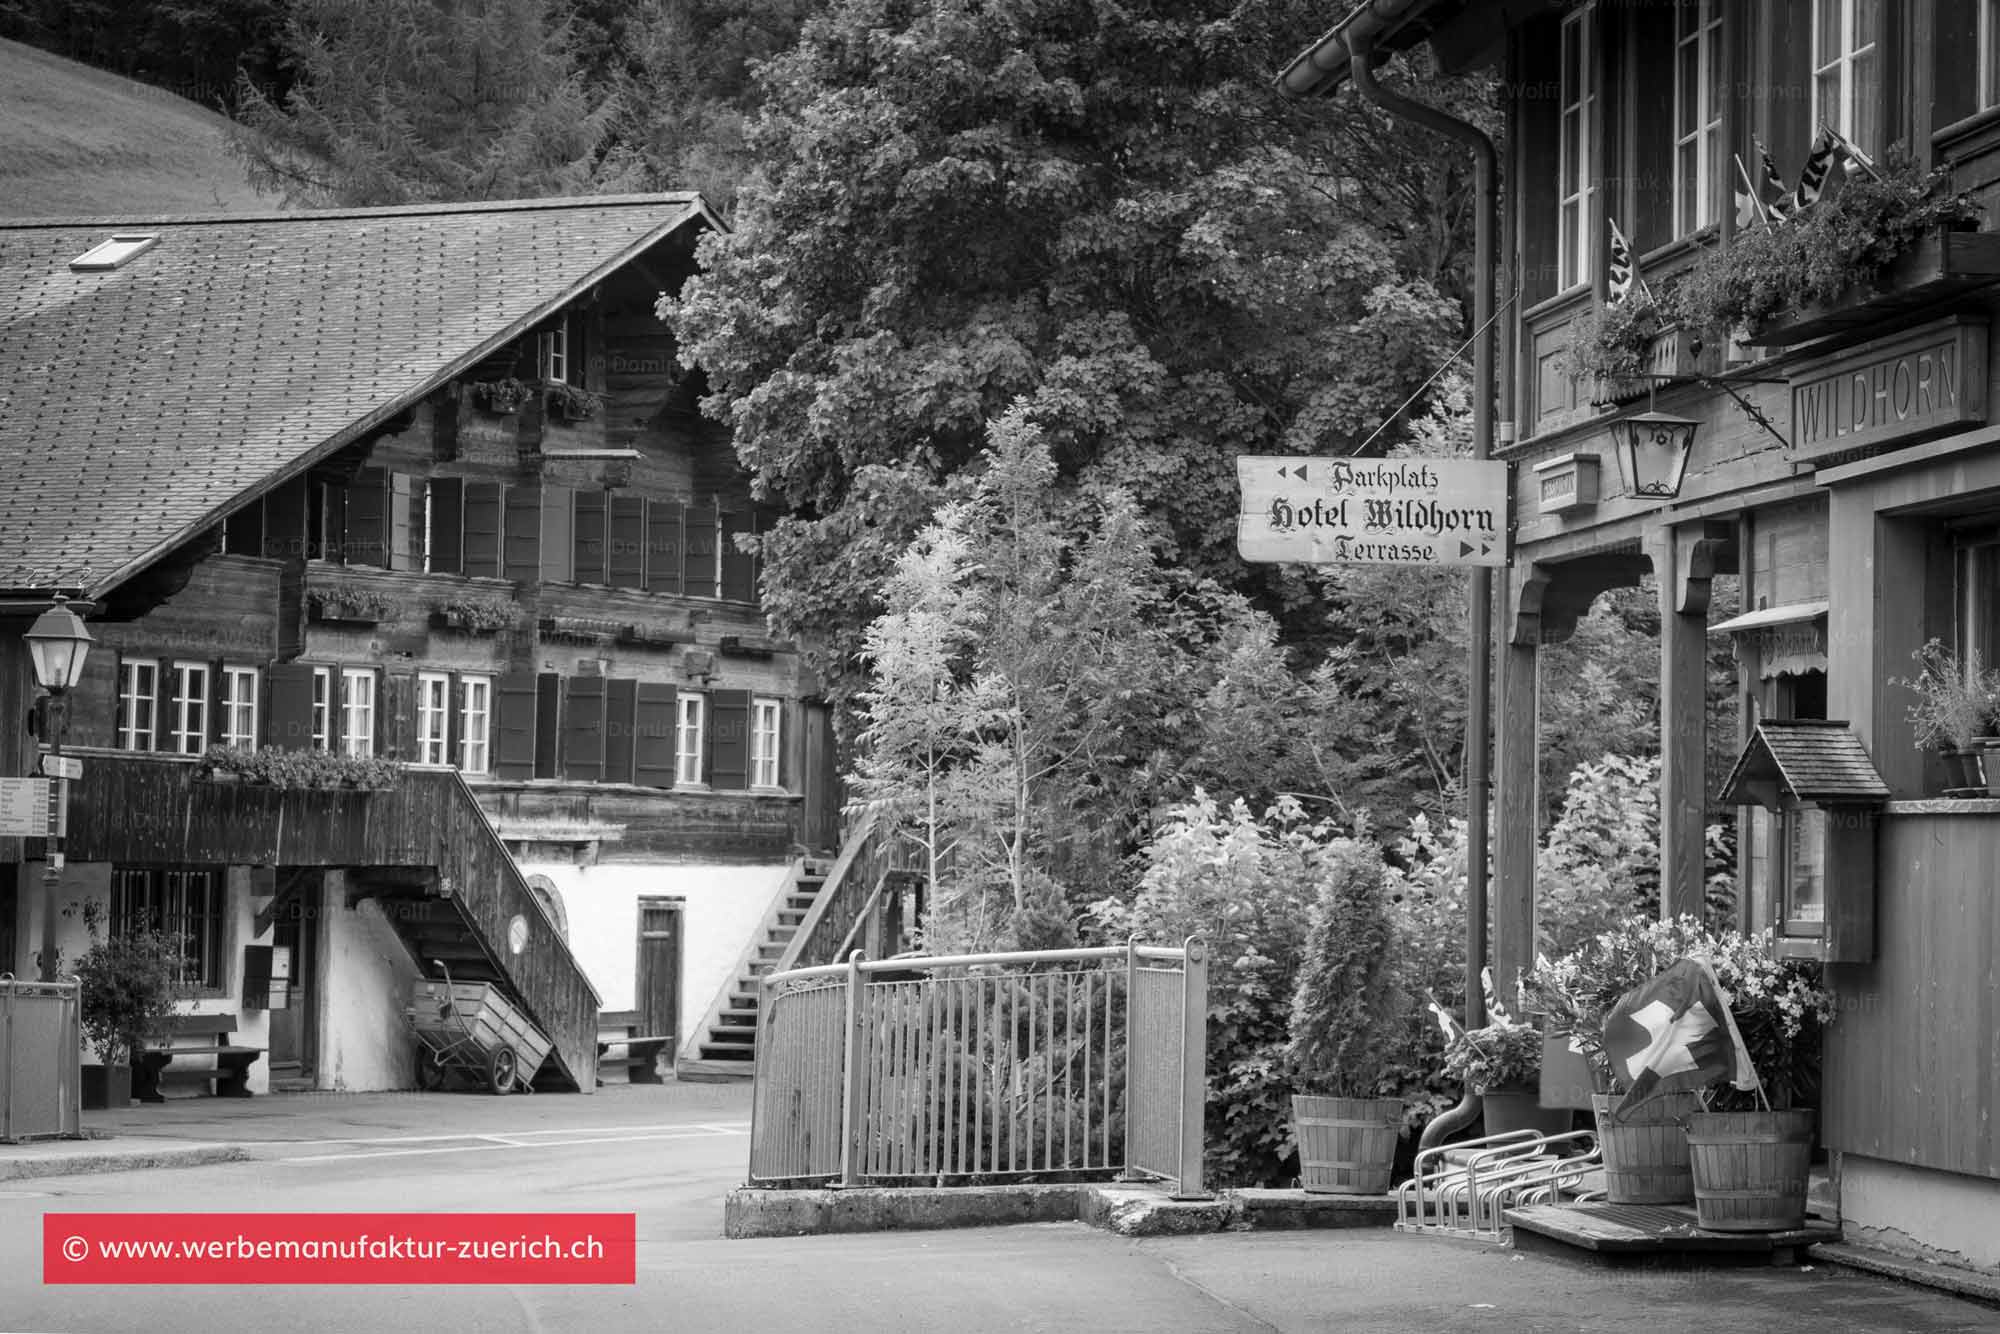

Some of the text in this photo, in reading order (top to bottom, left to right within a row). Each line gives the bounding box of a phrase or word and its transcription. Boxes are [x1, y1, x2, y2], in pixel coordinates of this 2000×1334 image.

[1801, 344, 1955, 445] WILDHORN
[1332, 462, 1438, 495] Parkplatz
[1271, 498, 1495, 534] Hotel Wildhorn
[1334, 535, 1433, 561] Terrasse
